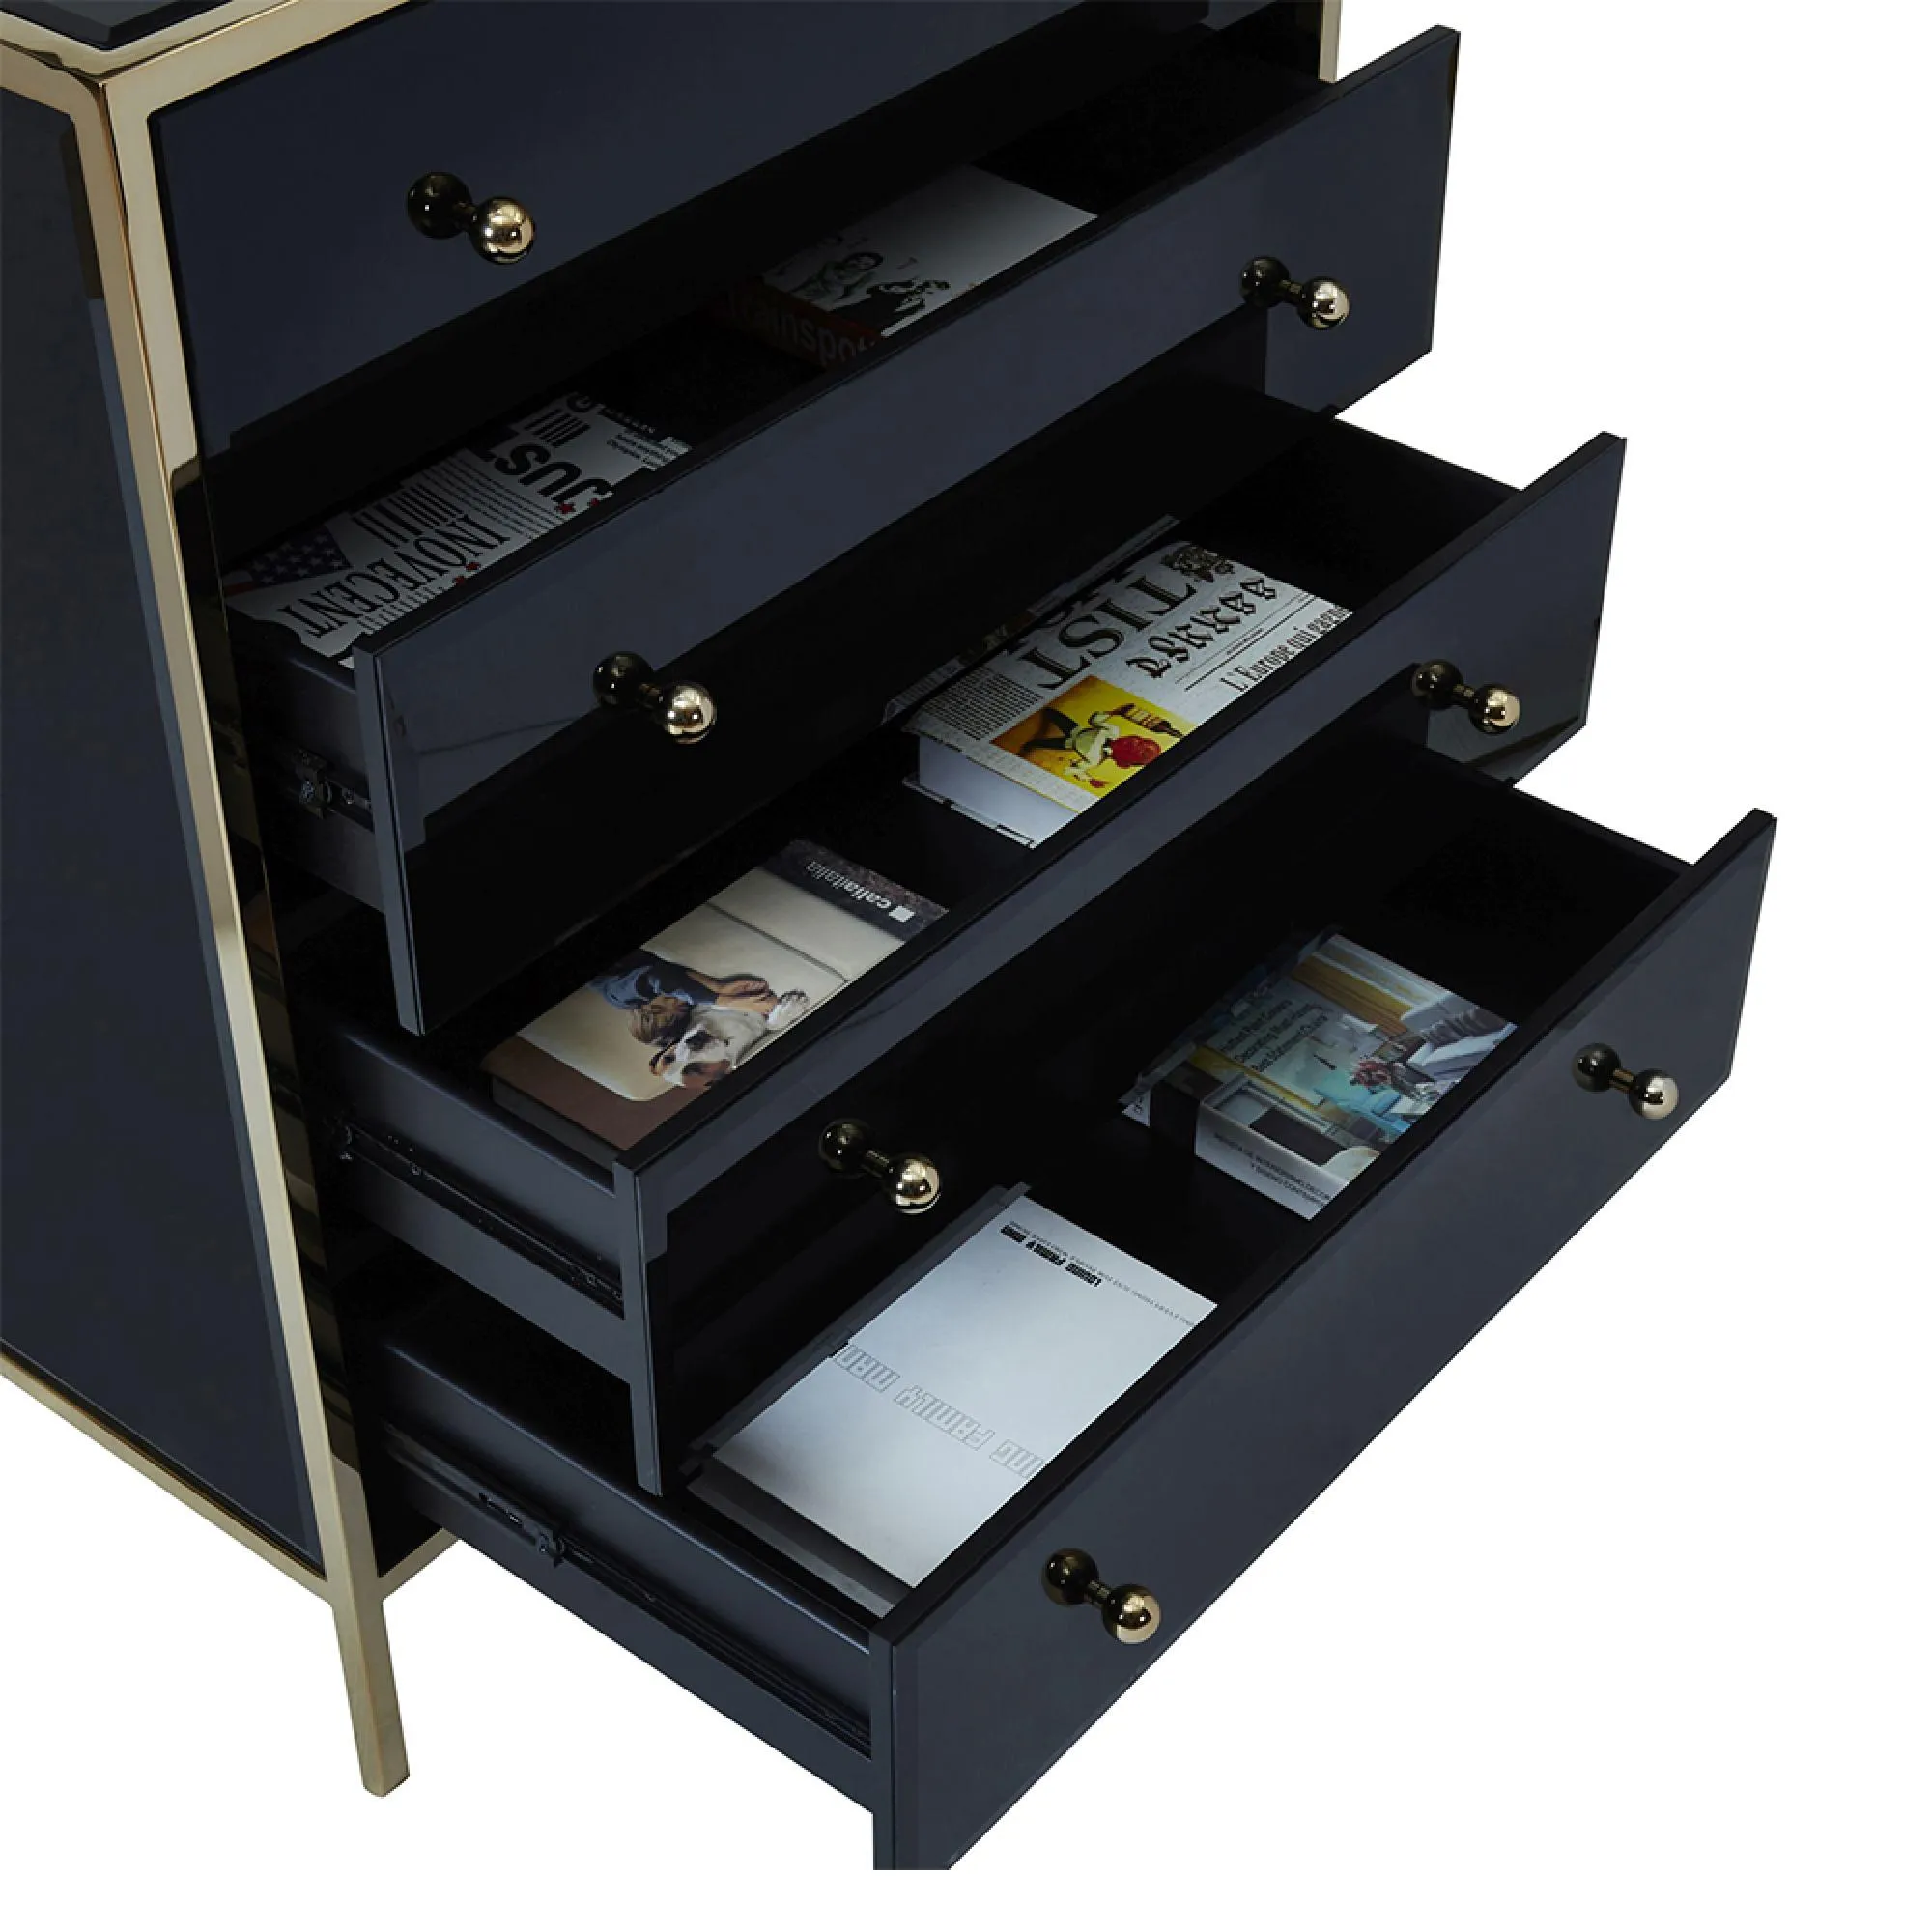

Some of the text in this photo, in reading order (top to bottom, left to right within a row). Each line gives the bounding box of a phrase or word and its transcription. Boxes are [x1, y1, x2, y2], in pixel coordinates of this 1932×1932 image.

[277, 513, 510, 638] INOVECENT
[1019, 577, 1197, 690] TIST
[1025, 1239, 1065, 1265] FAMILY
[893, 1386, 995, 1452] FAMILY
